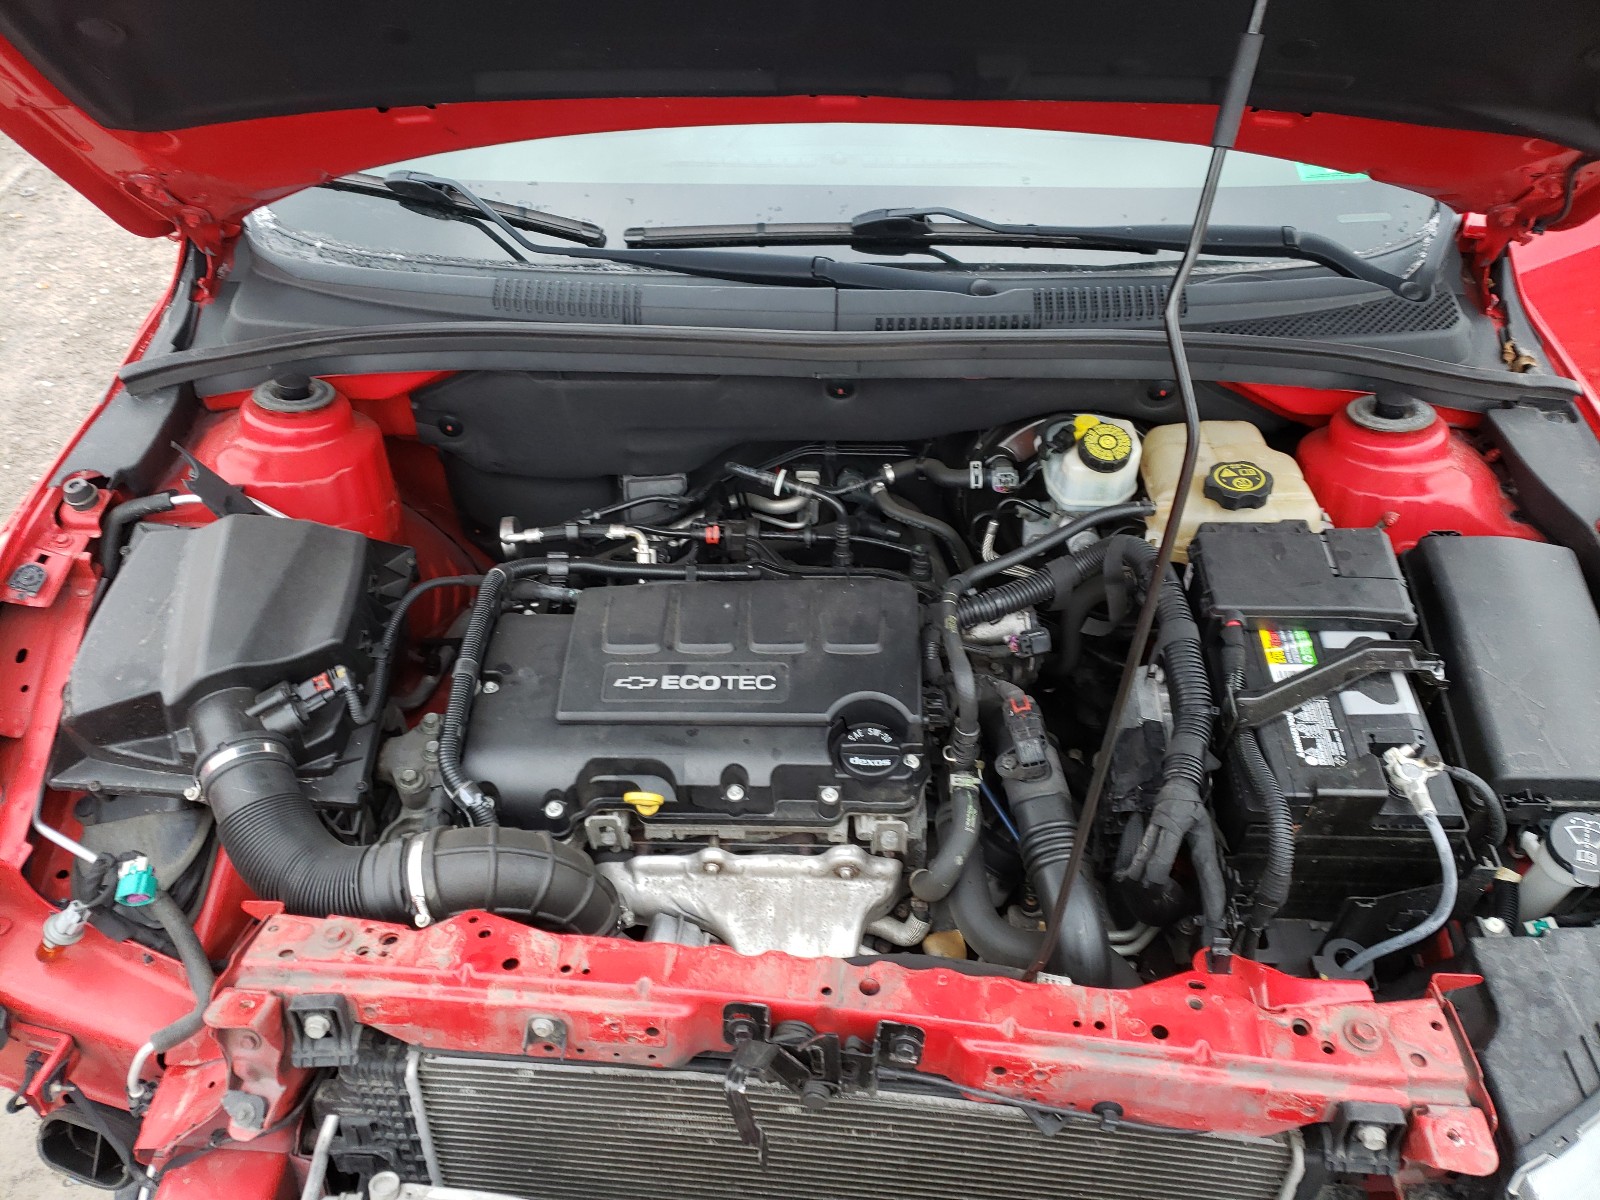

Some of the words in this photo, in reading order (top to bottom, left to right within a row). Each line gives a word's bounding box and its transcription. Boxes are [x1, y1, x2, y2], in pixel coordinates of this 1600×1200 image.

[660, 674, 777, 691] ECOTEC
[847, 728, 865, 742] SAE
[849, 756, 892, 767] dexos
